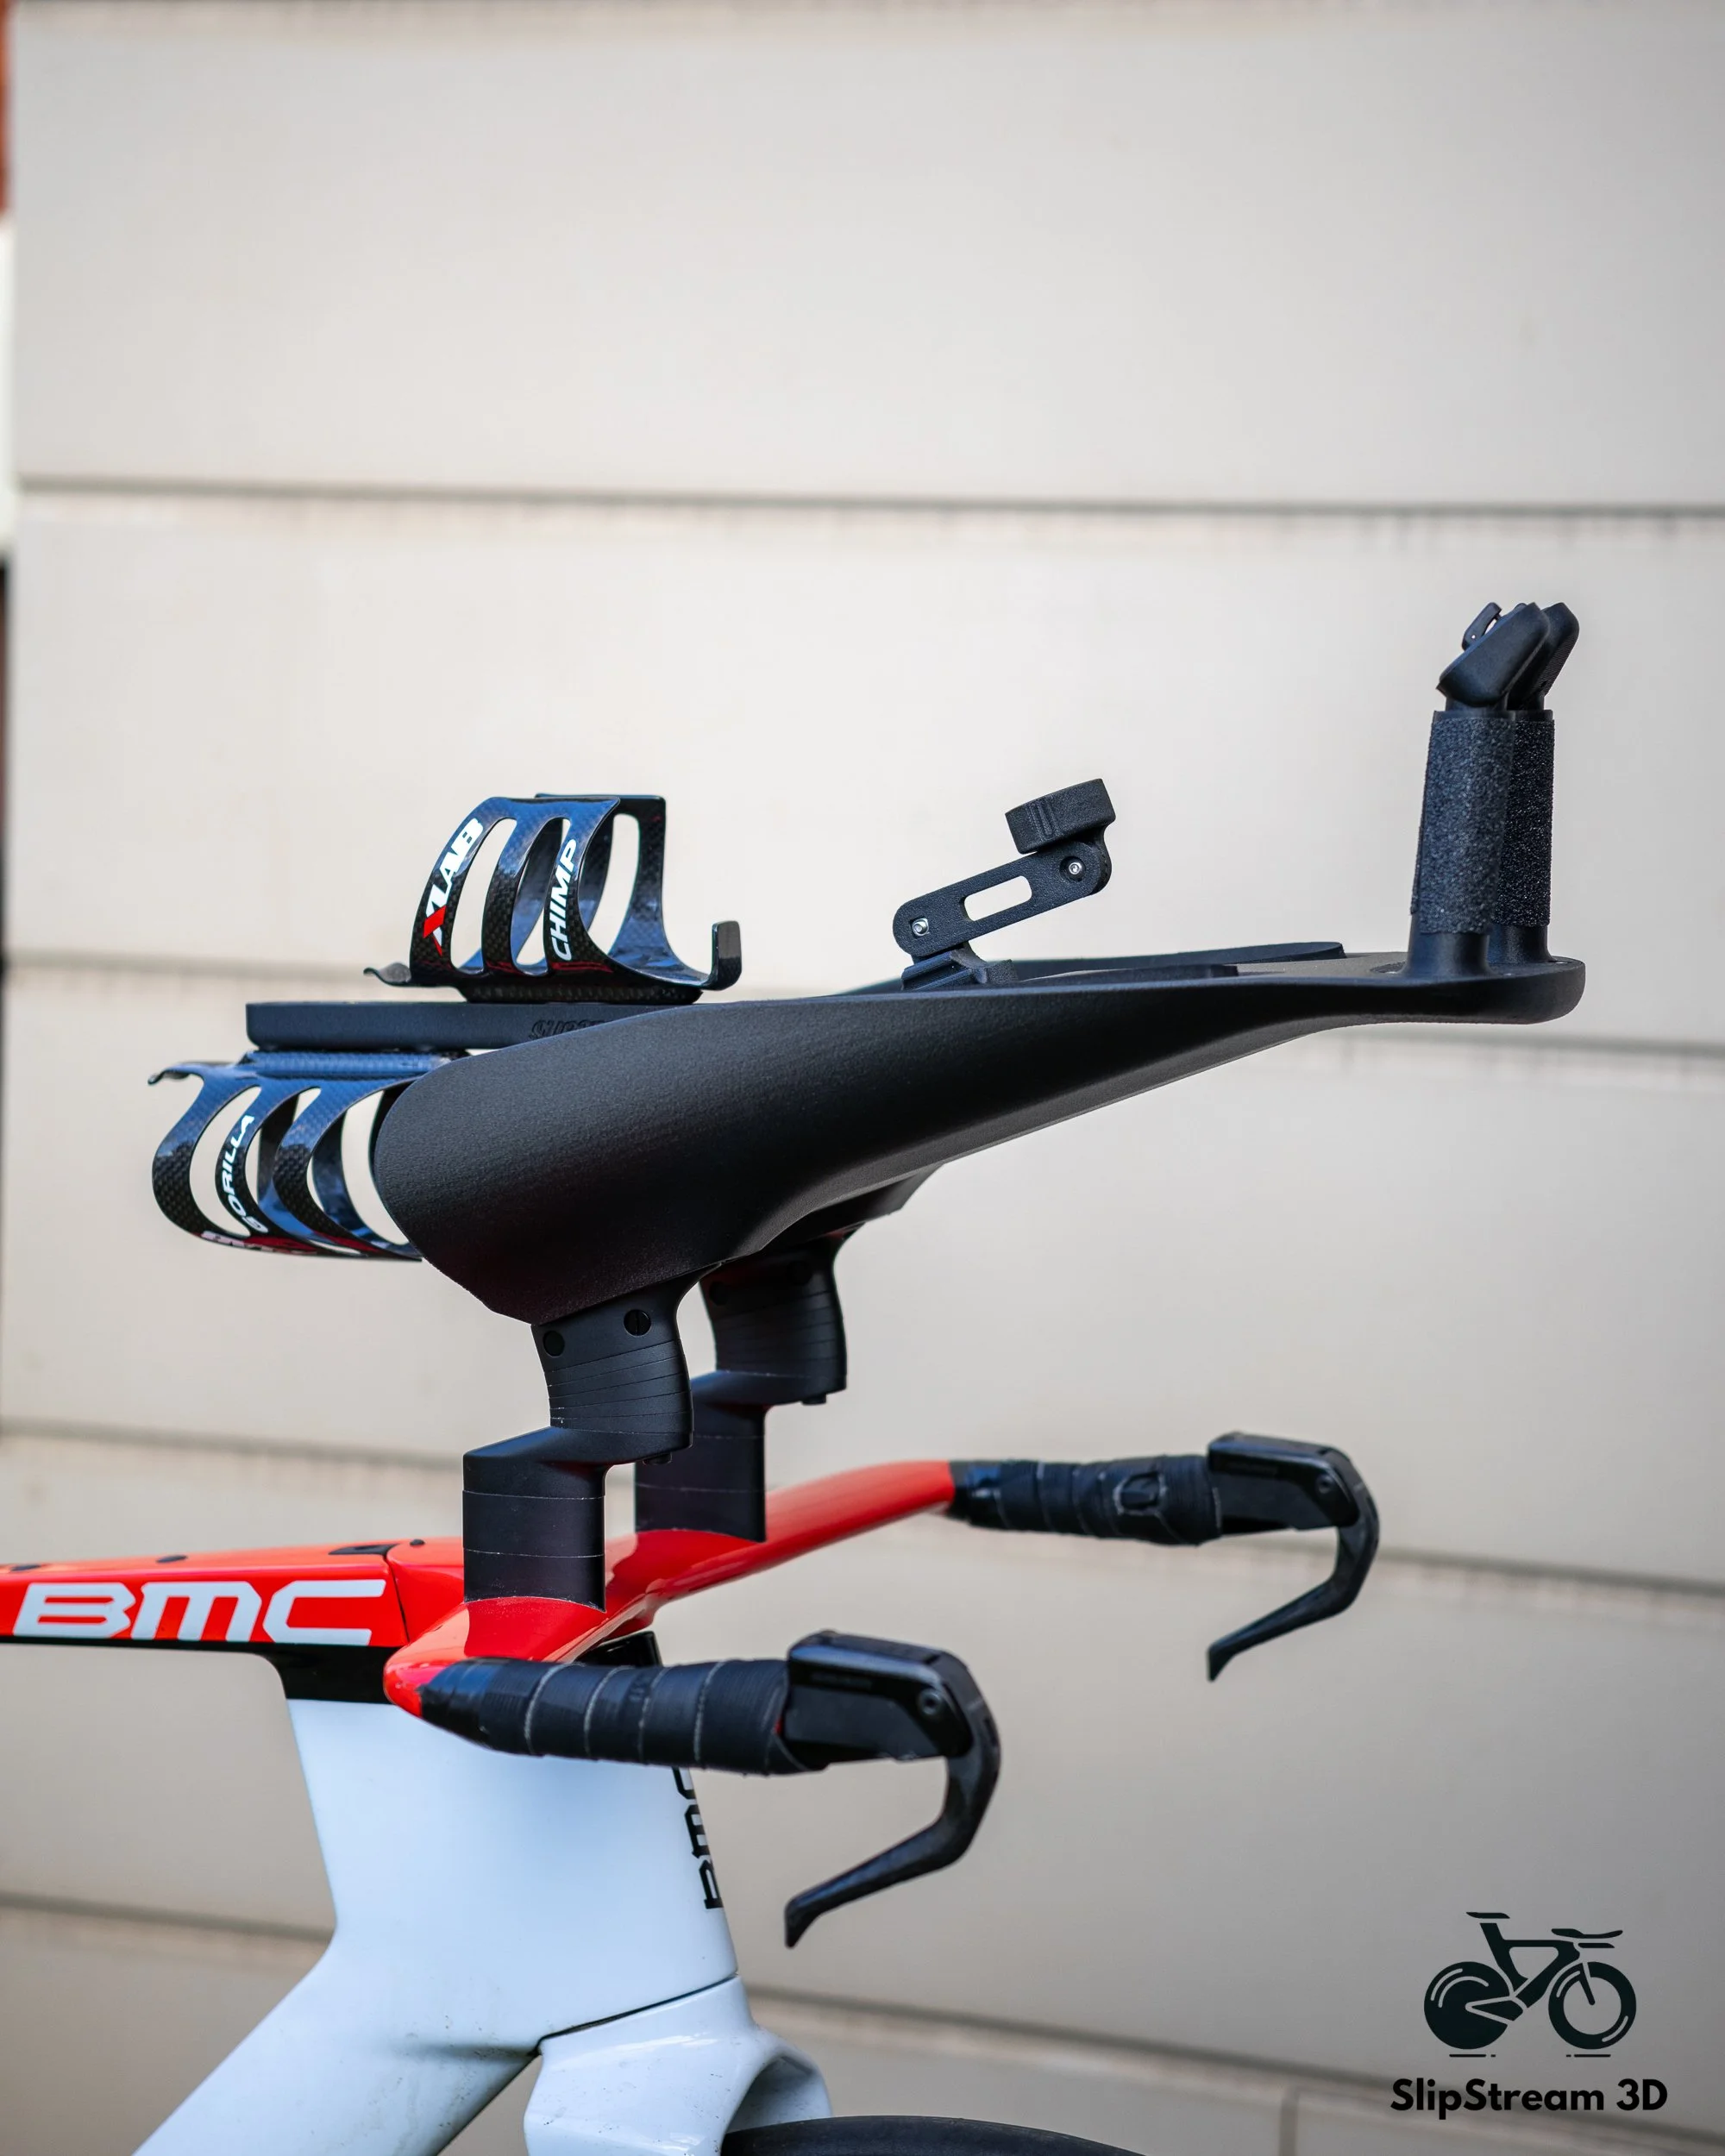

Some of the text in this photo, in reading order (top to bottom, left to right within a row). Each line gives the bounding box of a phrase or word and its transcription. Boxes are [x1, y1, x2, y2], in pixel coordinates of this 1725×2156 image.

[549, 838, 577, 961] CHIMP
[222, 1114, 269, 1233] GORILLA
[12, 1578, 386, 1646] BMC
